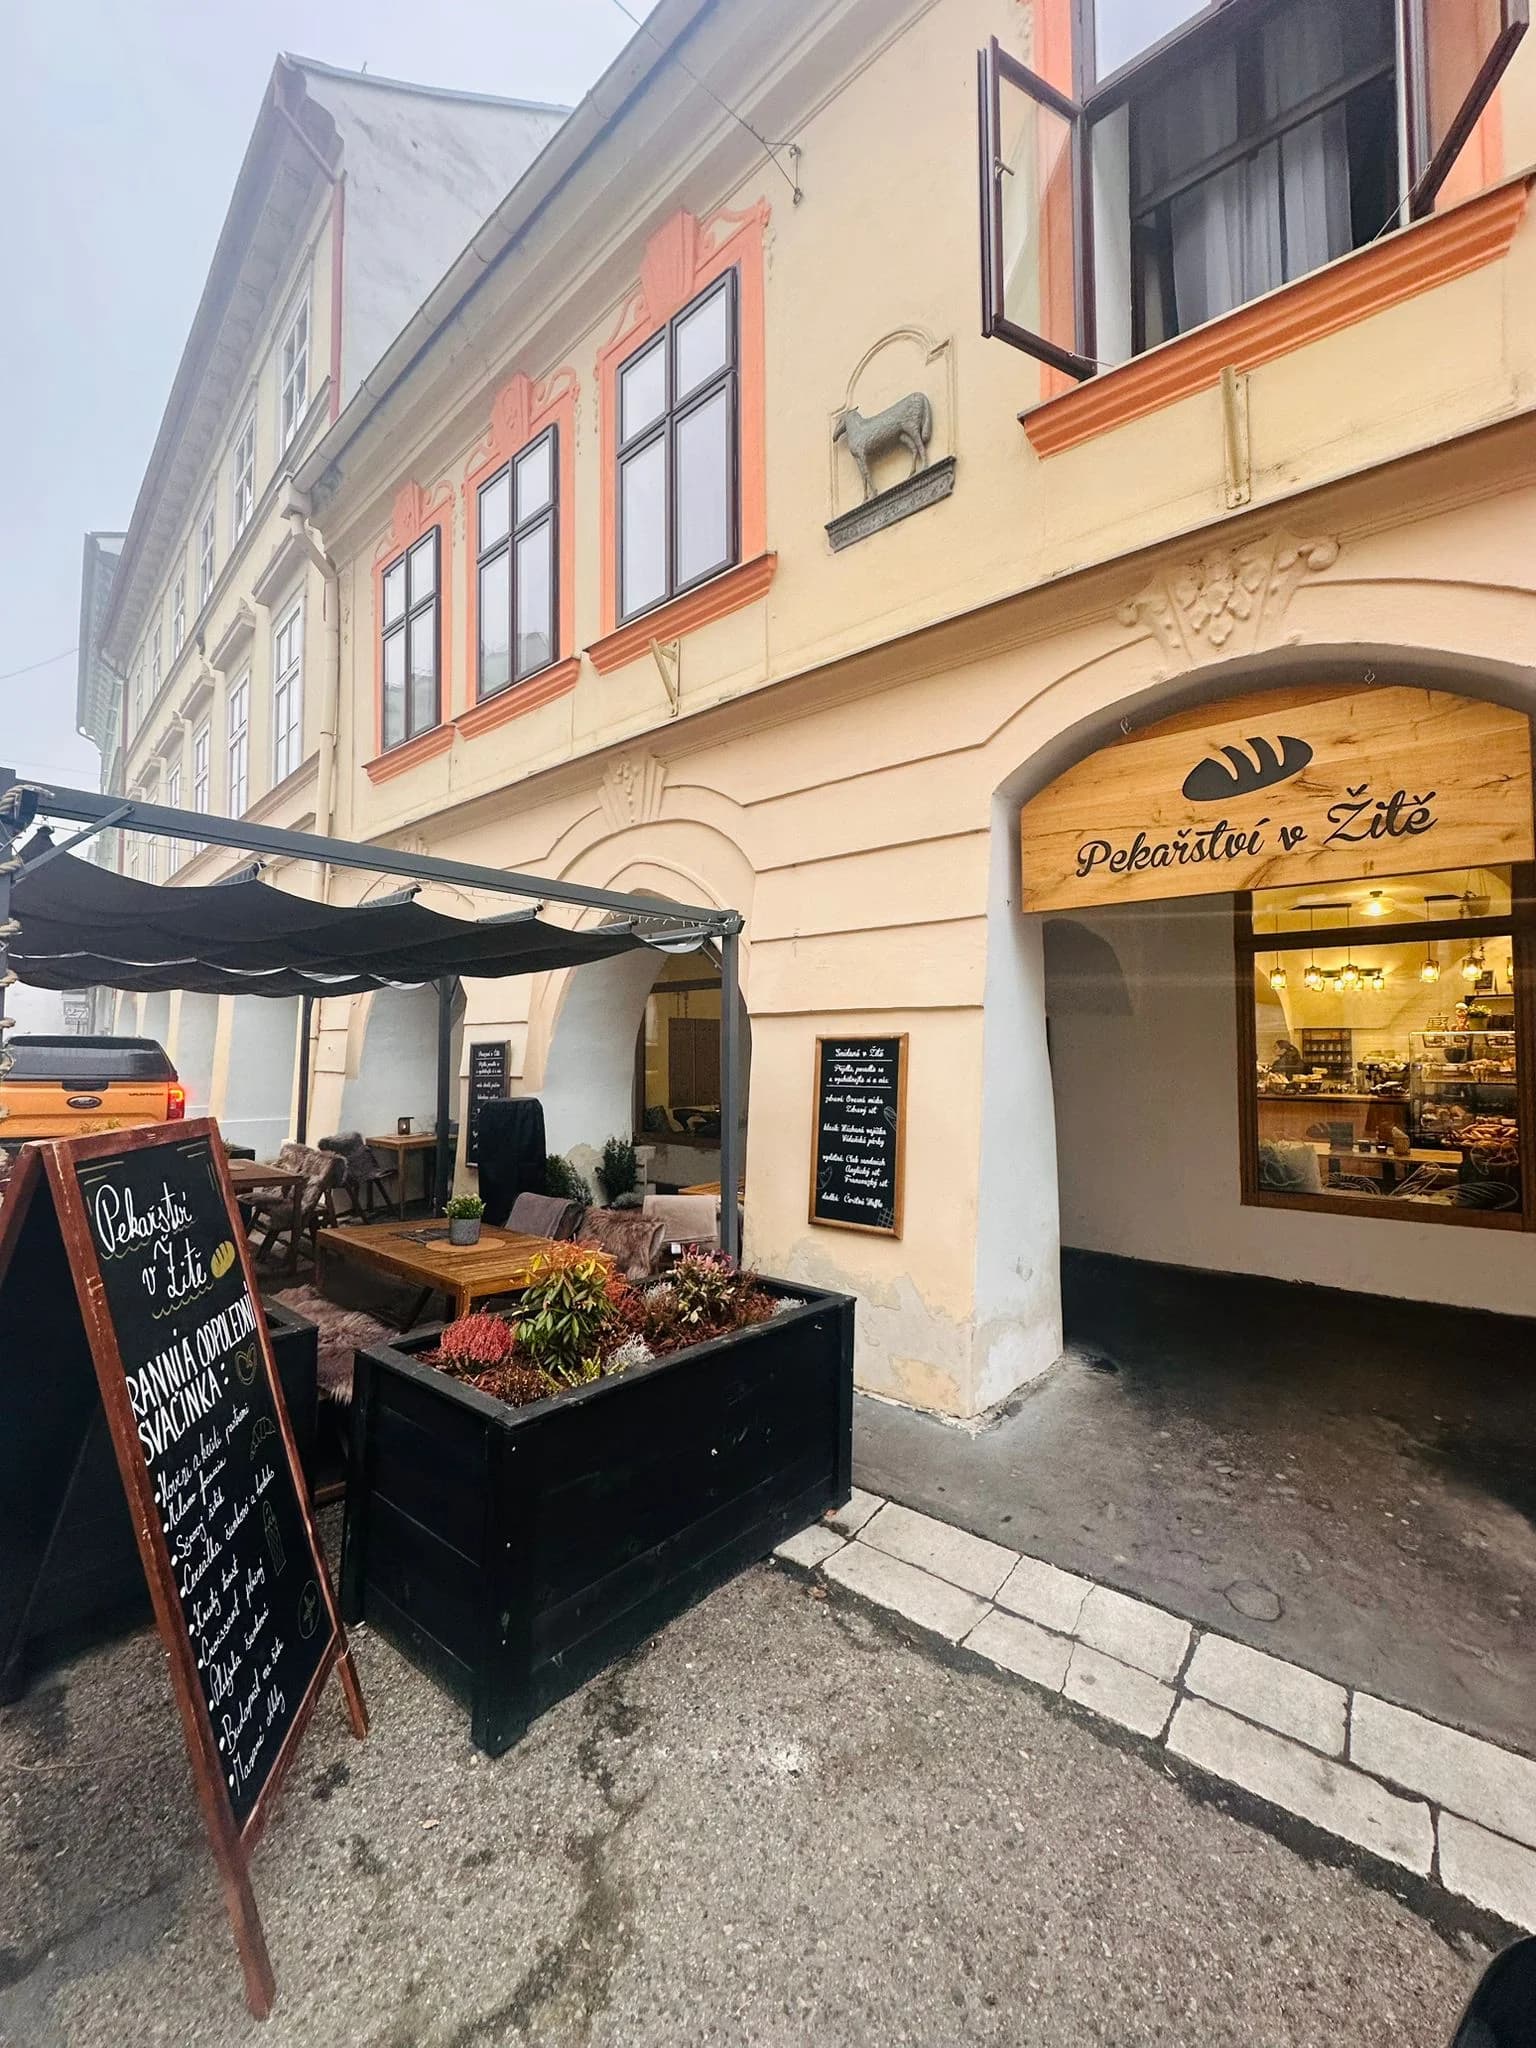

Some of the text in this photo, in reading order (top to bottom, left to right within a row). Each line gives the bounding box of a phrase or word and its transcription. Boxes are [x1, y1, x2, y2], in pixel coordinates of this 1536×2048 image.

[1076, 783, 1438, 878] Pekařství v Žitě
[96, 1181, 193, 1253] Pekařství
[142, 1233, 207, 1298] v Žitě
[202, 1589, 240, 1666] Croissant
